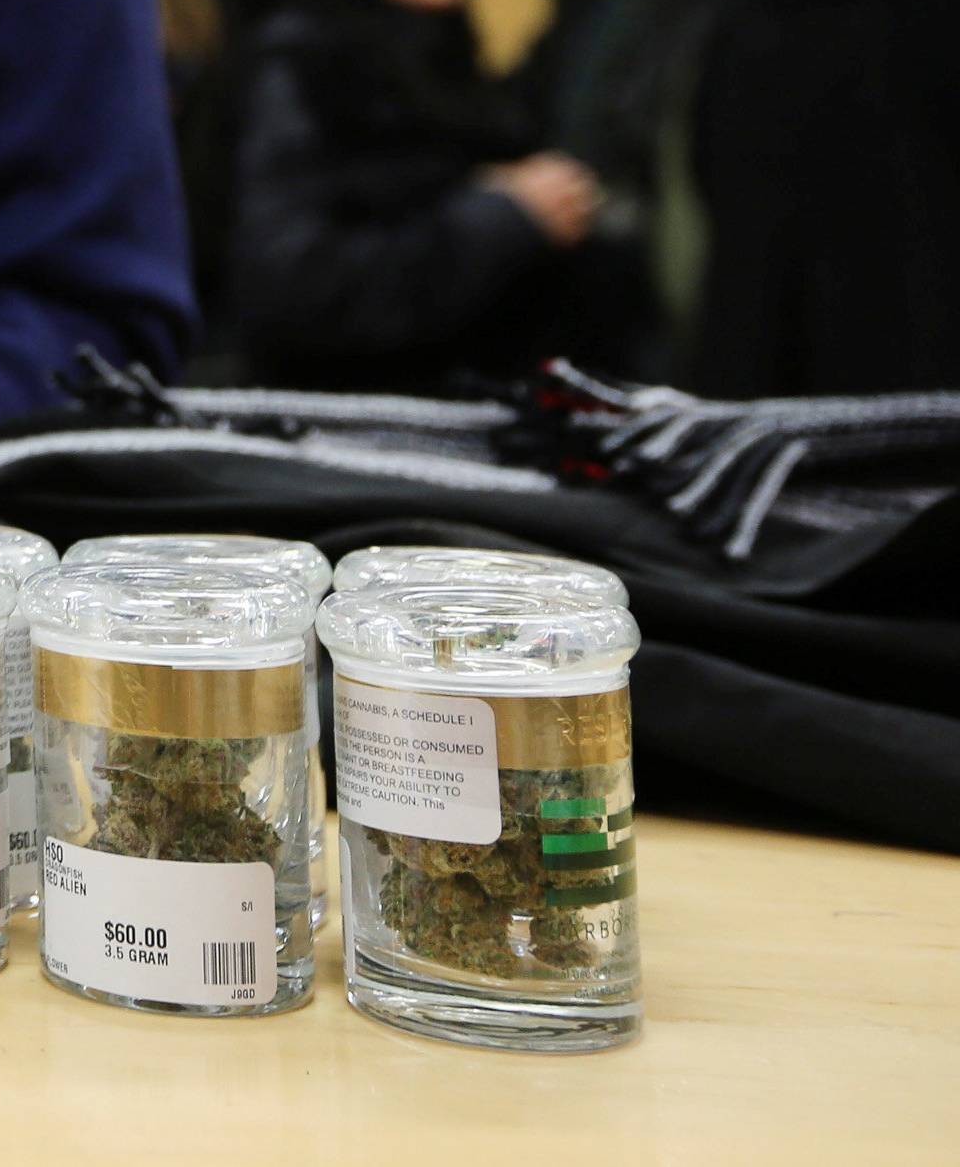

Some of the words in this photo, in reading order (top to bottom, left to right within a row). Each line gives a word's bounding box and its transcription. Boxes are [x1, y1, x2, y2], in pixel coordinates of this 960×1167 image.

[392, 710, 400, 718] A
[402, 712, 466, 725] SCHEDULE
[350, 741, 361, 752] THE
[364, 745, 401, 761] PERSON
[404, 755, 415, 763] IS
[417, 756, 426, 764] A
[393, 736, 409, 747] OR
[412, 738, 484, 755] CONSUMED
[359, 758, 369, 767] OR
[372, 760, 464, 783] BREASTFEEDING
[370, 774, 396, 788] YOUR
[398, 778, 441, 795] ABILITY
[441, 786, 461, 797] TO
[371, 788, 419, 806] CAUTION.
[423, 798, 445, 810] This
[46, 841, 63, 863] HSO
[46, 869, 58, 886] RED
[60, 877, 87, 896] ALIEN
[104, 921, 168, 949] $60.00
[105, 944, 124, 959] 3.5
[129, 949, 169, 967] GRAM
